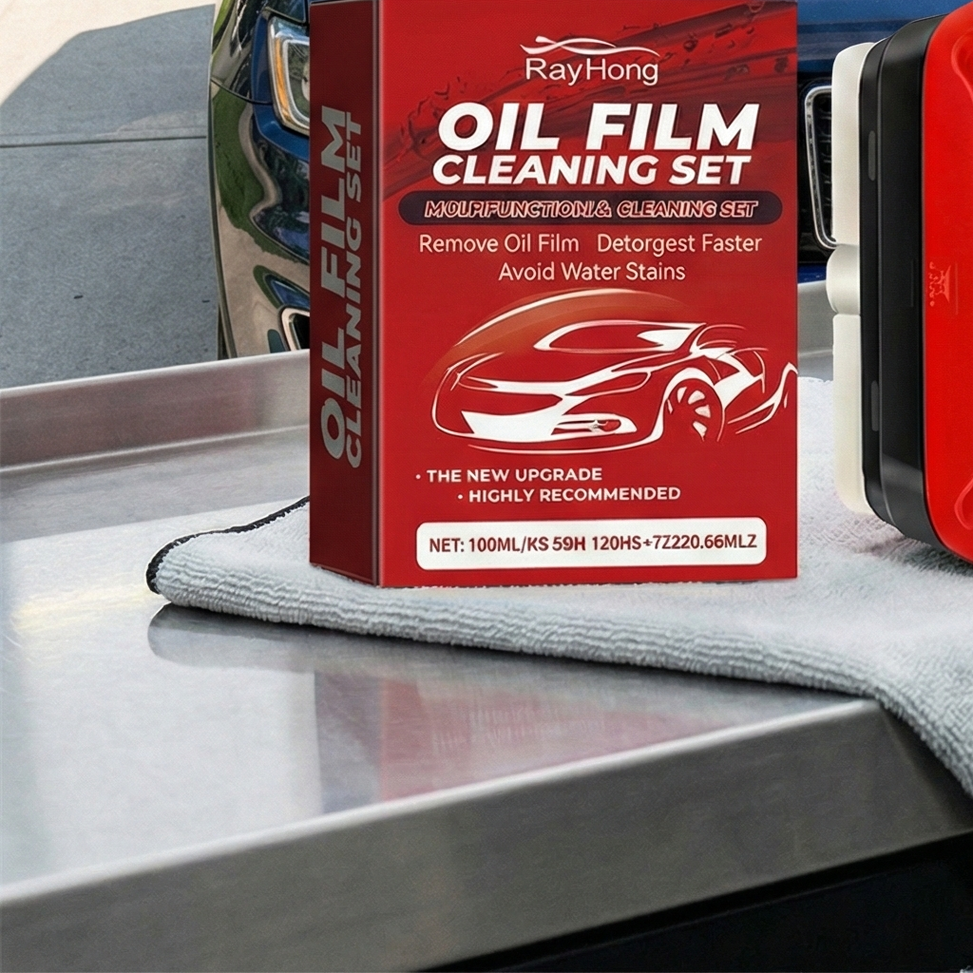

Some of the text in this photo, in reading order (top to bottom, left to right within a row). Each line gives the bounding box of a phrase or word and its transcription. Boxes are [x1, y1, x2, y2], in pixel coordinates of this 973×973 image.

[525, 58, 659, 86] RayHong
[438, 102, 760, 151] OIL FILM
[432, 155, 752, 185] CLEANING SET
[616, 199, 716, 218] CLEANING
[719, 199, 758, 218] SET
[419, 232, 762, 257] Remove Oil Film Detorgest Faster
[321, 105, 346, 460] OIL FILM
[498, 262, 686, 281] Avoid Water Stains
[346, 112, 362, 468] CLEANING SET
[427, 468, 602, 483] THE NEW UPGRADE
[469, 487, 681, 503] HIGHLY RECOMMENDED
[429, 538, 464, 552] NET:
[469, 536, 549, 553] 100ML/KS
[552, 536, 586, 551] 59H
